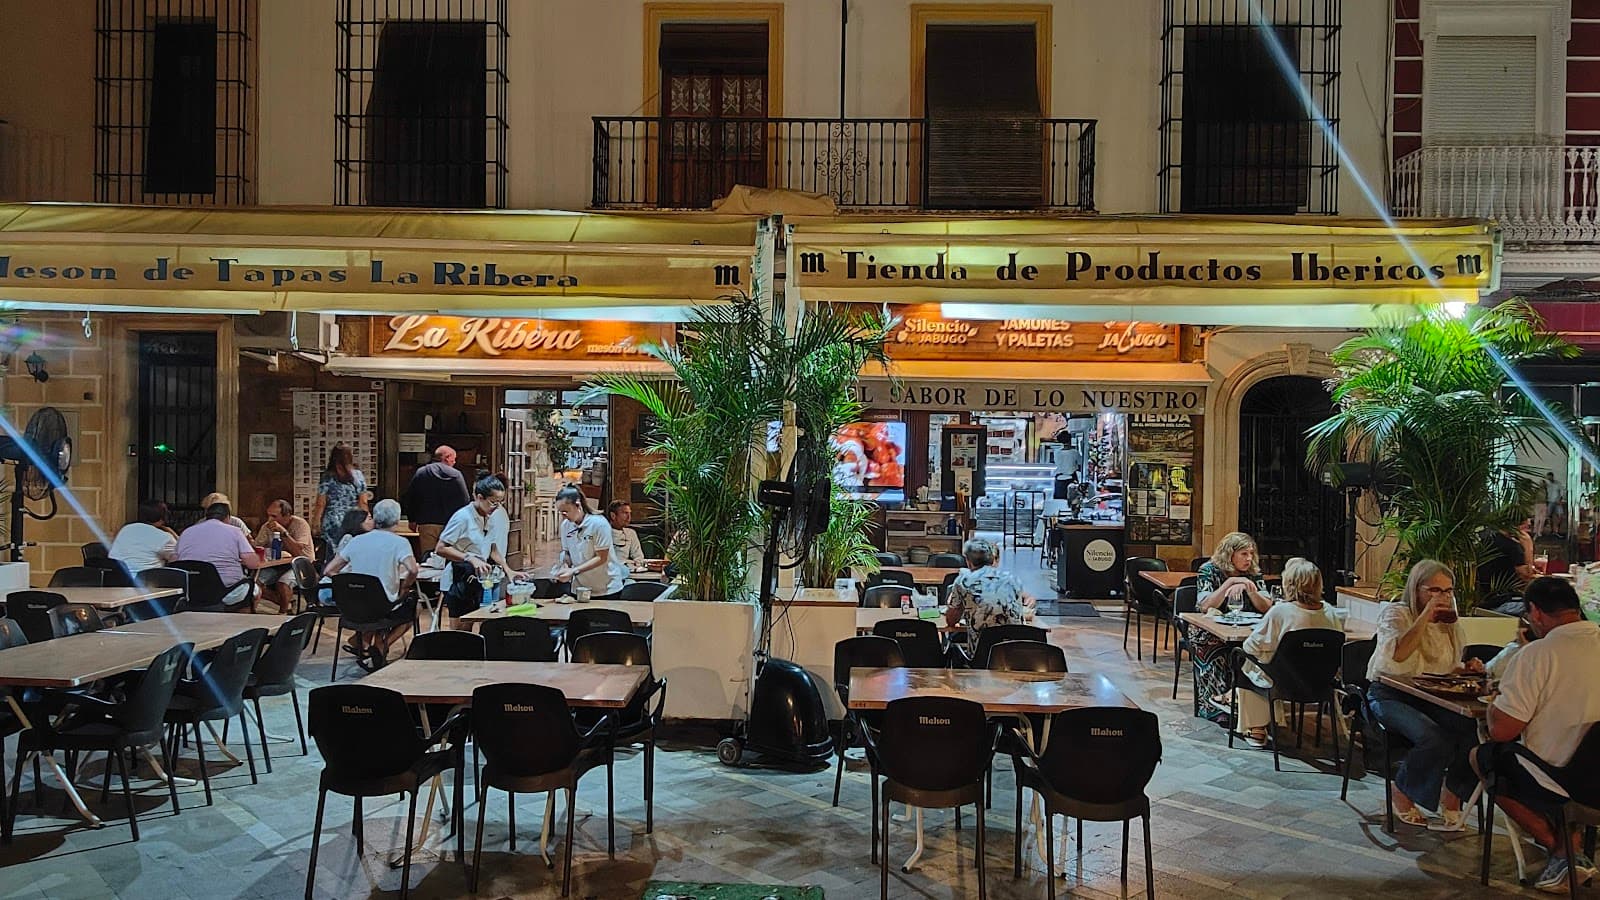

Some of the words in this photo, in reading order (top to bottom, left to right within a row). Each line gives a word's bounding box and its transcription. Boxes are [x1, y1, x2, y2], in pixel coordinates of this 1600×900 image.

[841, 250, 967, 280] Tienda
[996, 249, 1039, 280] de
[1065, 251, 1262, 281] Productos
[1291, 252, 1445, 281] Ibericos
[143, 257, 194, 281] de
[209, 257, 347, 287] Tapas
[370, 260, 418, 285] La
[433, 261, 578, 287] Ribera
[905, 319, 970, 333] Silencio
[384, 314, 449, 350] La
[456, 318, 582, 355] Ribera
[920, 334, 967, 344] JABUGO
[995, 334, 1005, 346] Y
[1008, 333, 1074, 347] PALETAS
[890, 387, 967, 405] SABOR
[984, 389, 1017, 406] DE
[1033, 390, 1065, 407] LO
[1081, 390, 1198, 409] NUESTRO
[1133, 413, 1191, 423] TIENDA
[341, 704, 373, 714] Mahou
[503, 703, 534, 712] Mahou
[918, 716, 951, 725] Mahou
[1090, 727, 1124, 737] Mahou
